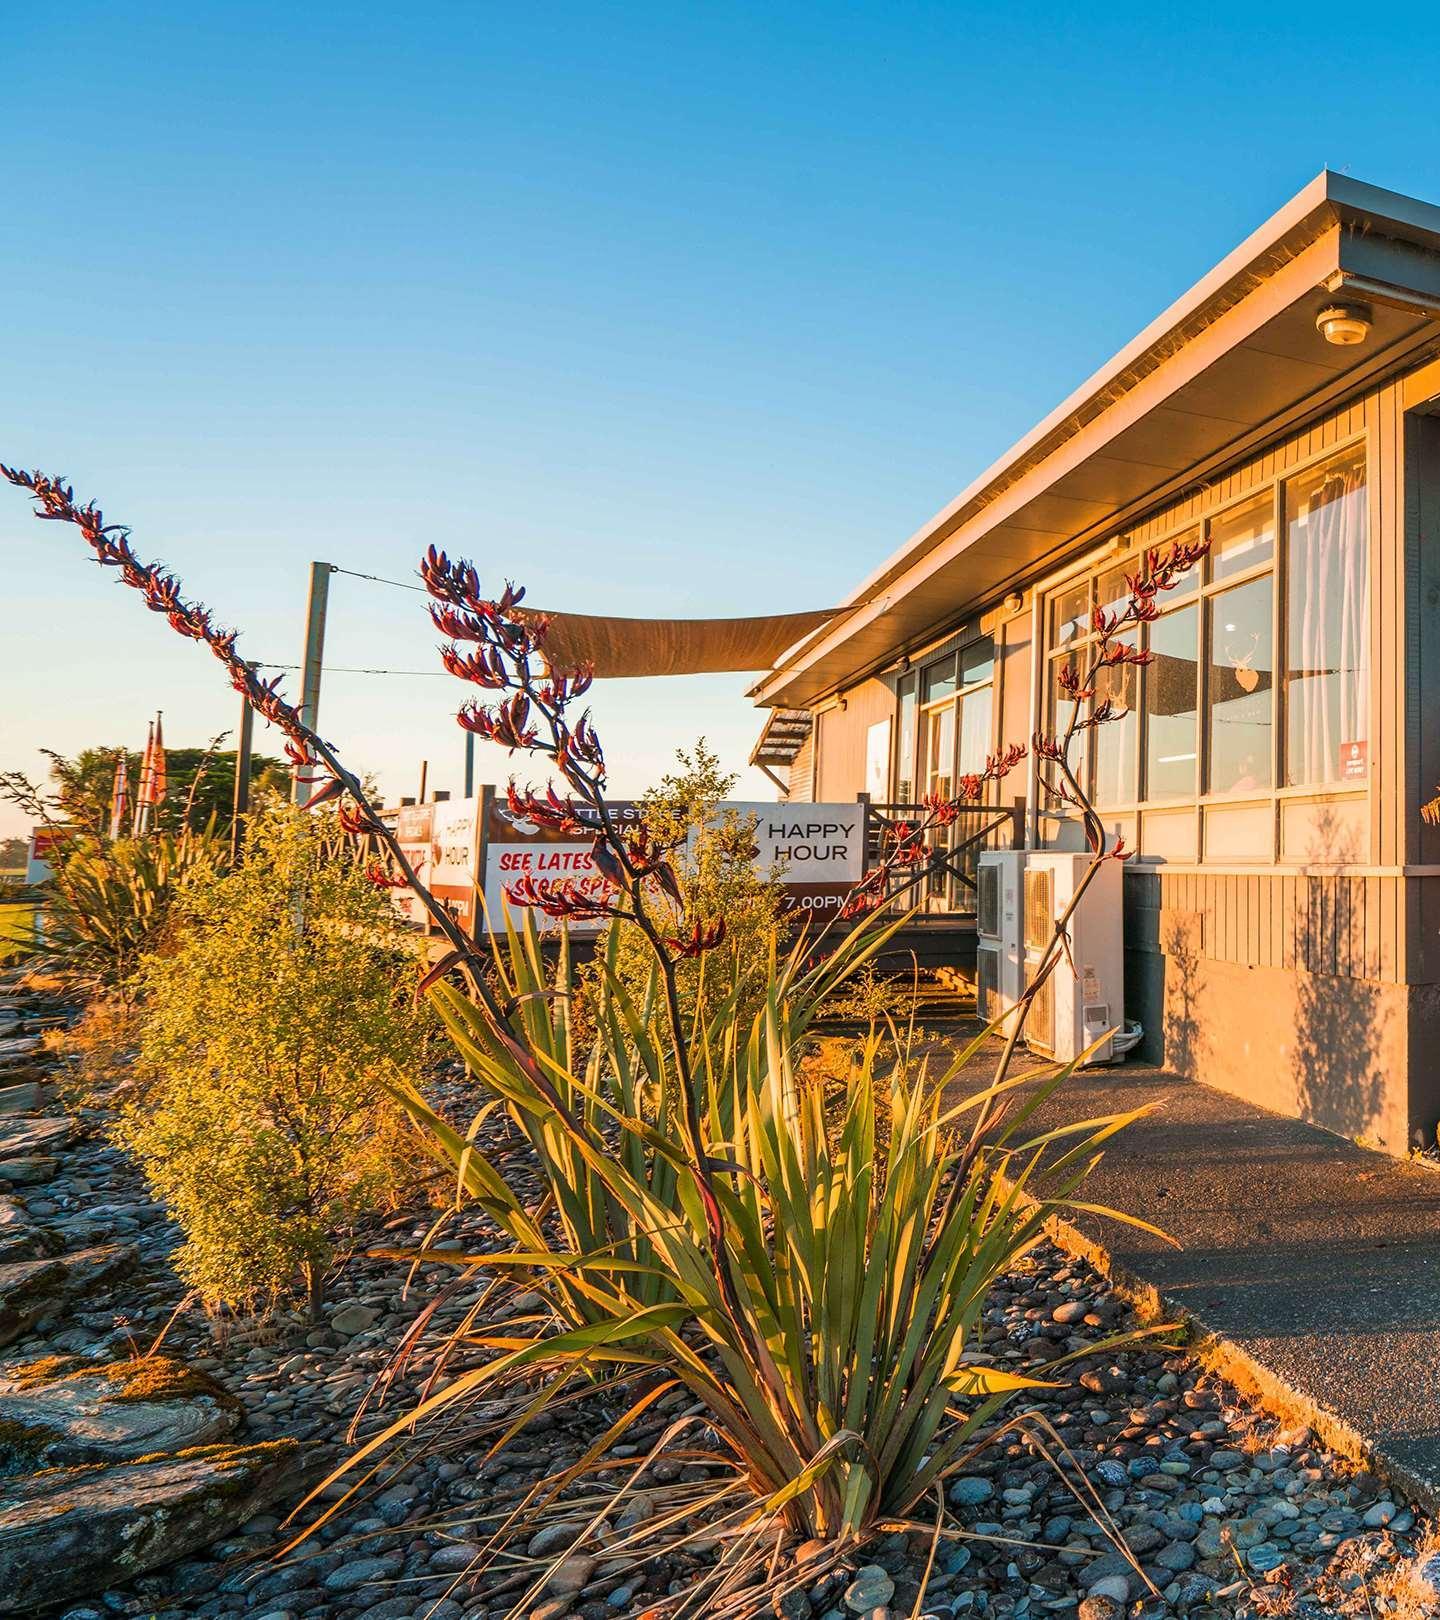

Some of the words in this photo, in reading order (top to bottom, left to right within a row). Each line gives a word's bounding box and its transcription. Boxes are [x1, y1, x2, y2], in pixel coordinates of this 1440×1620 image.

[768, 823, 856, 839] HAPPY
[774, 845, 848, 861] HOUR
[499, 852, 533, 871] SEE
[537, 852, 594, 871] LATES
